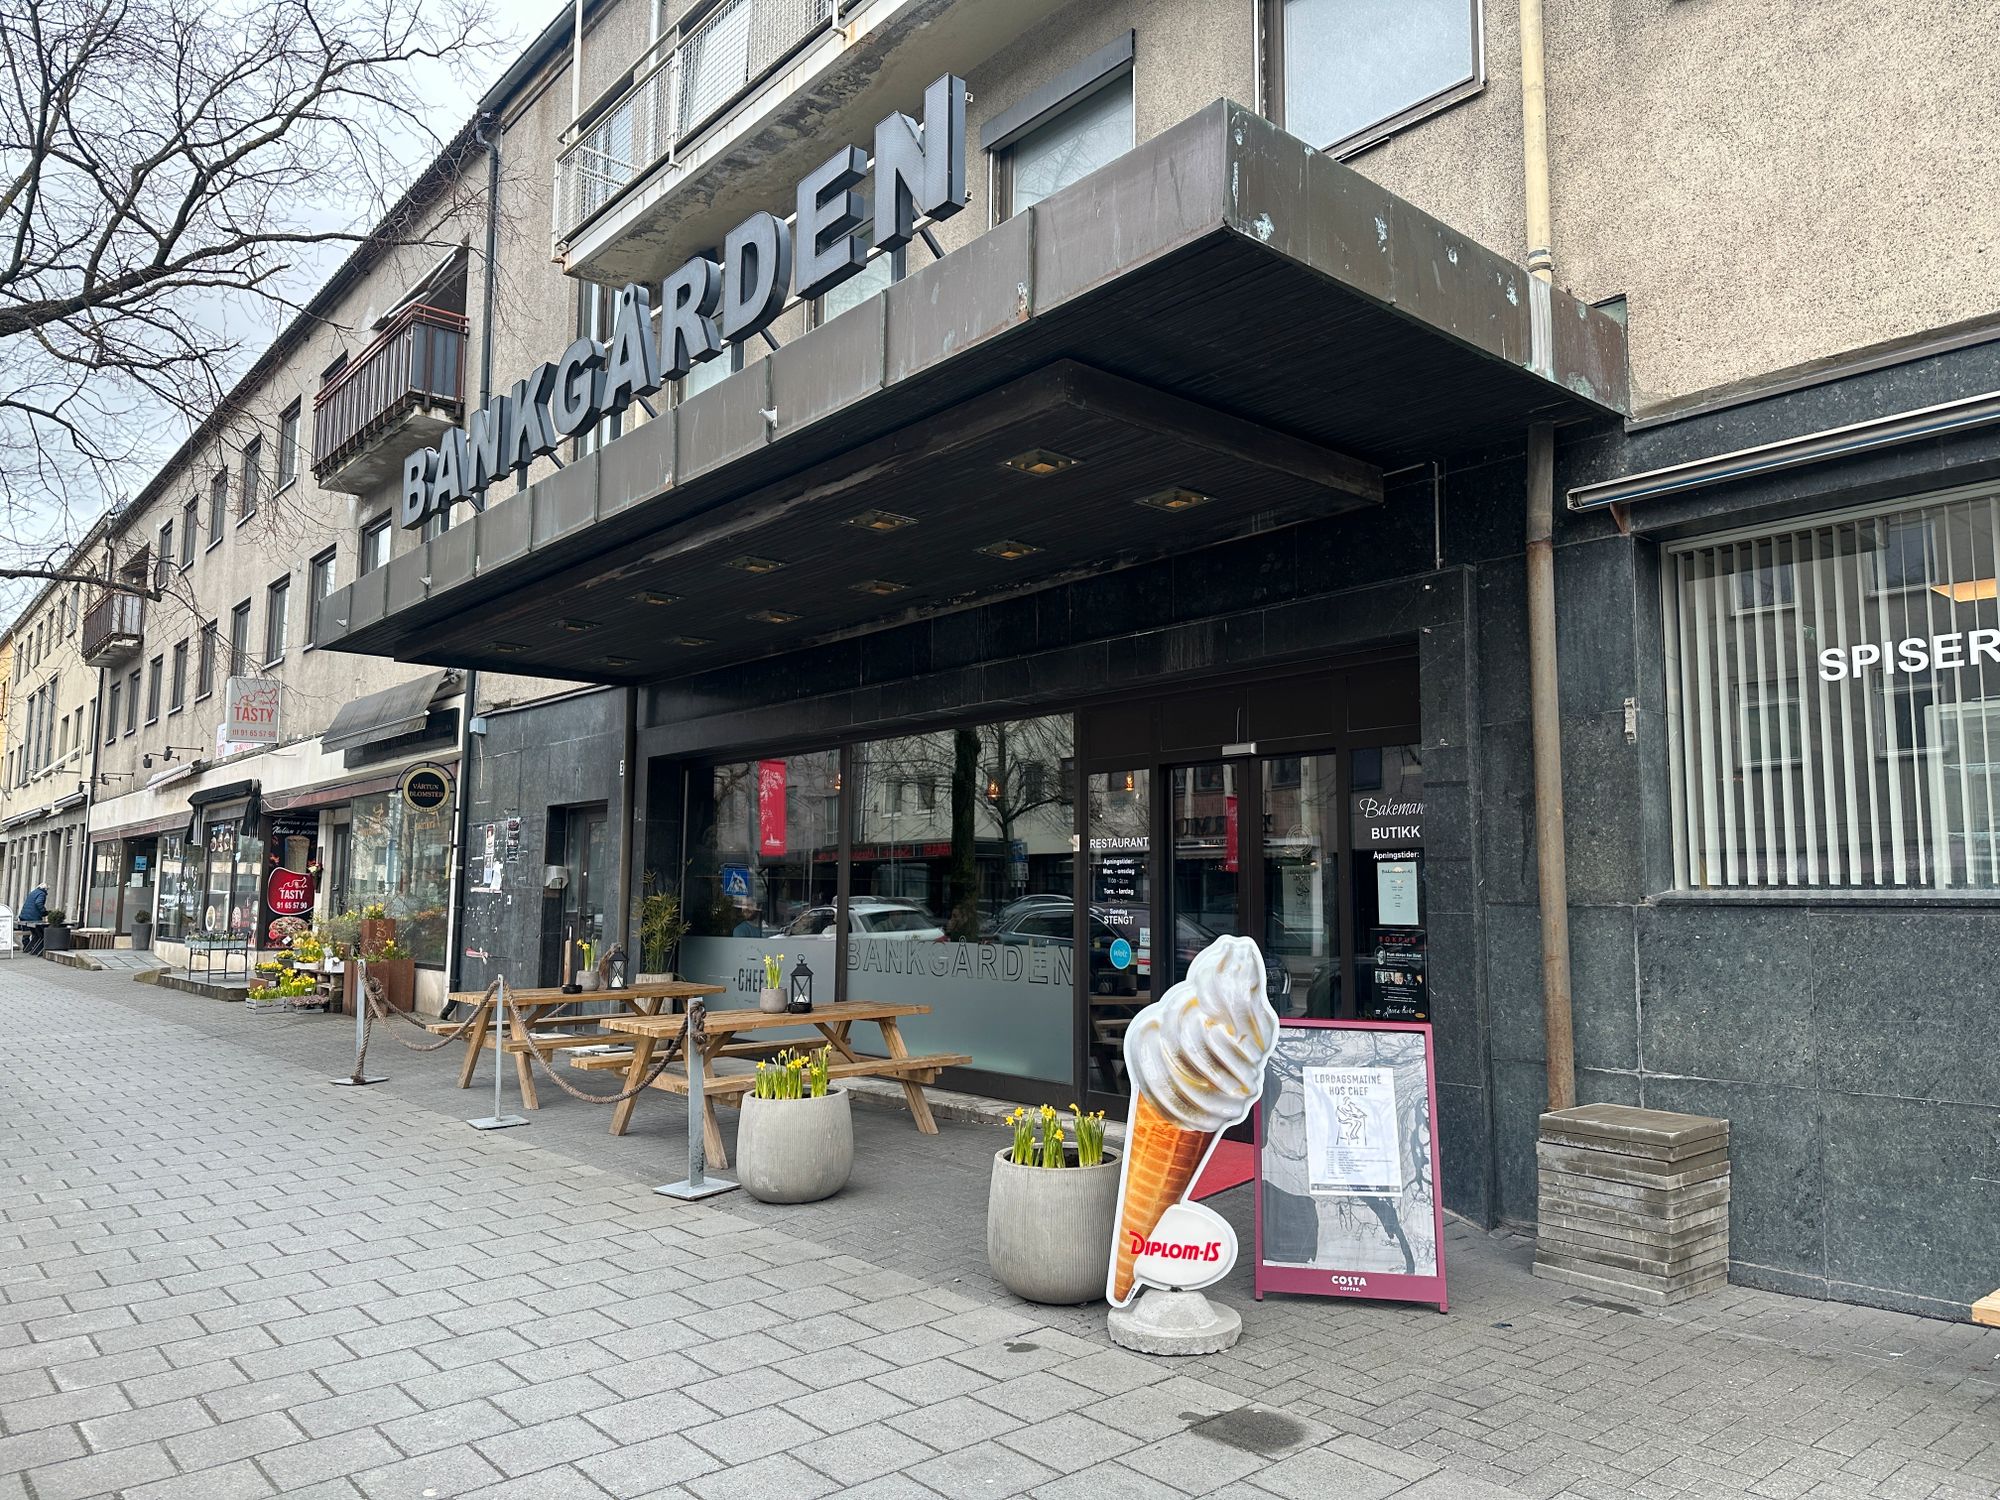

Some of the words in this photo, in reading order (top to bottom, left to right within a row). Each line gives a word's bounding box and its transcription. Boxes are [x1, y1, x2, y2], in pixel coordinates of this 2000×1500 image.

[401, 72, 966, 530] BANKGÅRDEN
[1819, 629, 2000, 682] SPISER
[234, 706, 275, 722] TASTY
[1371, 825, 1421, 840] BUTIKK
[1089, 836, 1149, 849] RESTAURANT
[280, 889, 305, 900] TASTY
[276, 901, 284, 909] 91
[284, 901, 292, 909] 65
[1103, 915, 1134, 925] STENGT
[846, 935, 1074, 986] BANKGÅRDEN
[1329, 1086, 1346, 1096] HOS
[1348, 1086, 1369, 1096] CHEF
[1331, 1275, 1367, 1286] COSTA
